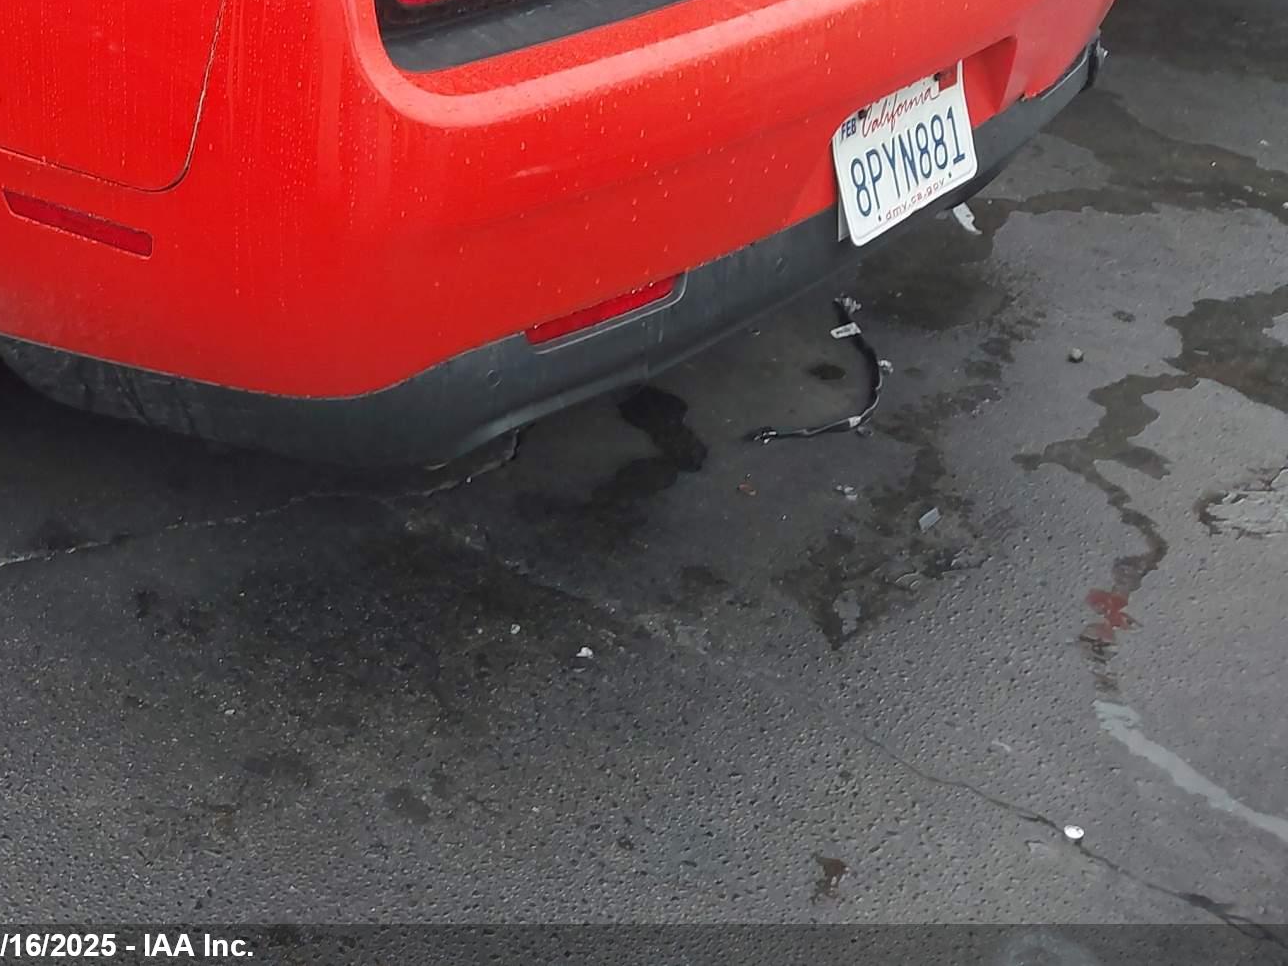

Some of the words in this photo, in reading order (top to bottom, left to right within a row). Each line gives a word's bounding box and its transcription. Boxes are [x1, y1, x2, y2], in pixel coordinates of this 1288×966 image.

[841, 118, 857, 140] FEB
[861, 81, 940, 138] California
[850, 106, 966, 218] 8PYN881
[885, 178, 945, 221] dmv.ca.gov
